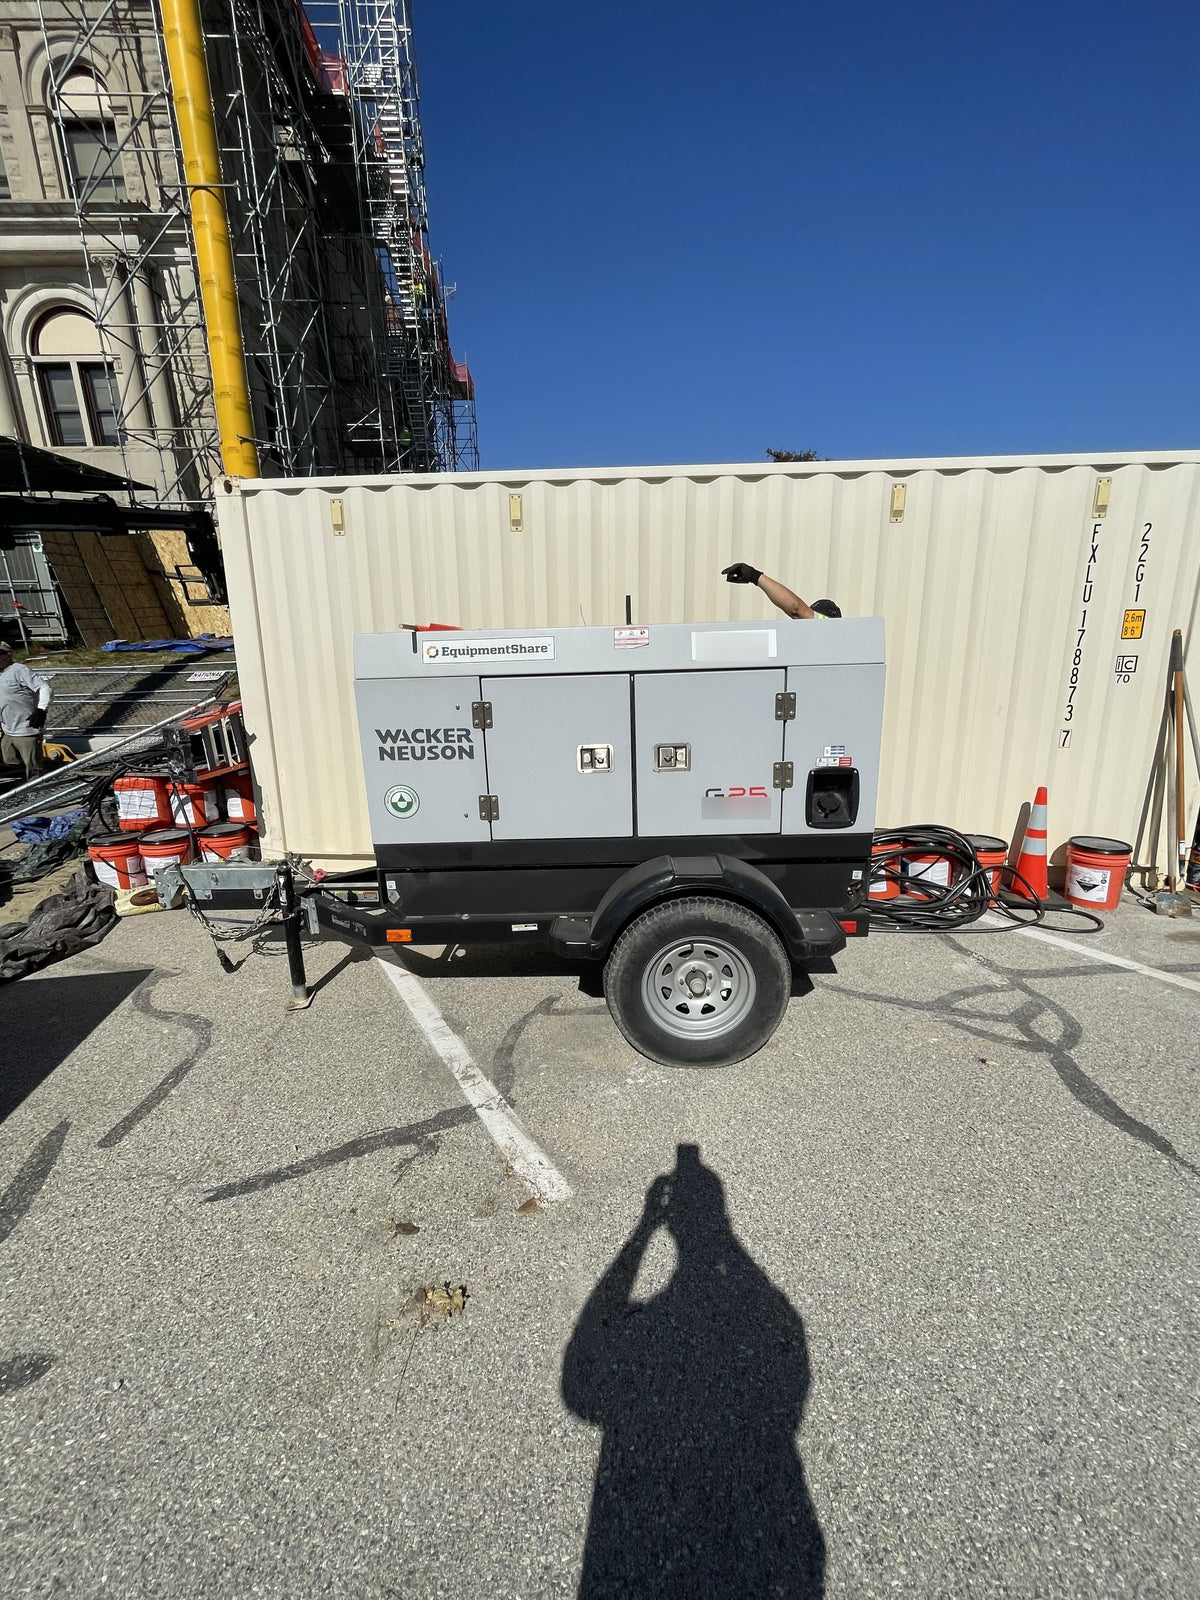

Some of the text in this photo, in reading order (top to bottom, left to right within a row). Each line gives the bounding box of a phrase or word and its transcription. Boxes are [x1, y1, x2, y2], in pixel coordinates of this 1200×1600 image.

[1134, 523, 1153, 603] 22G1
[1061, 524, 1102, 747] FXLU 178873 7
[441, 644, 548, 659] EquipmentShare
[1116, 674, 1131, 683] 70
[375, 728, 474, 744] WACKER
[379, 745, 475, 761] NEUSON
